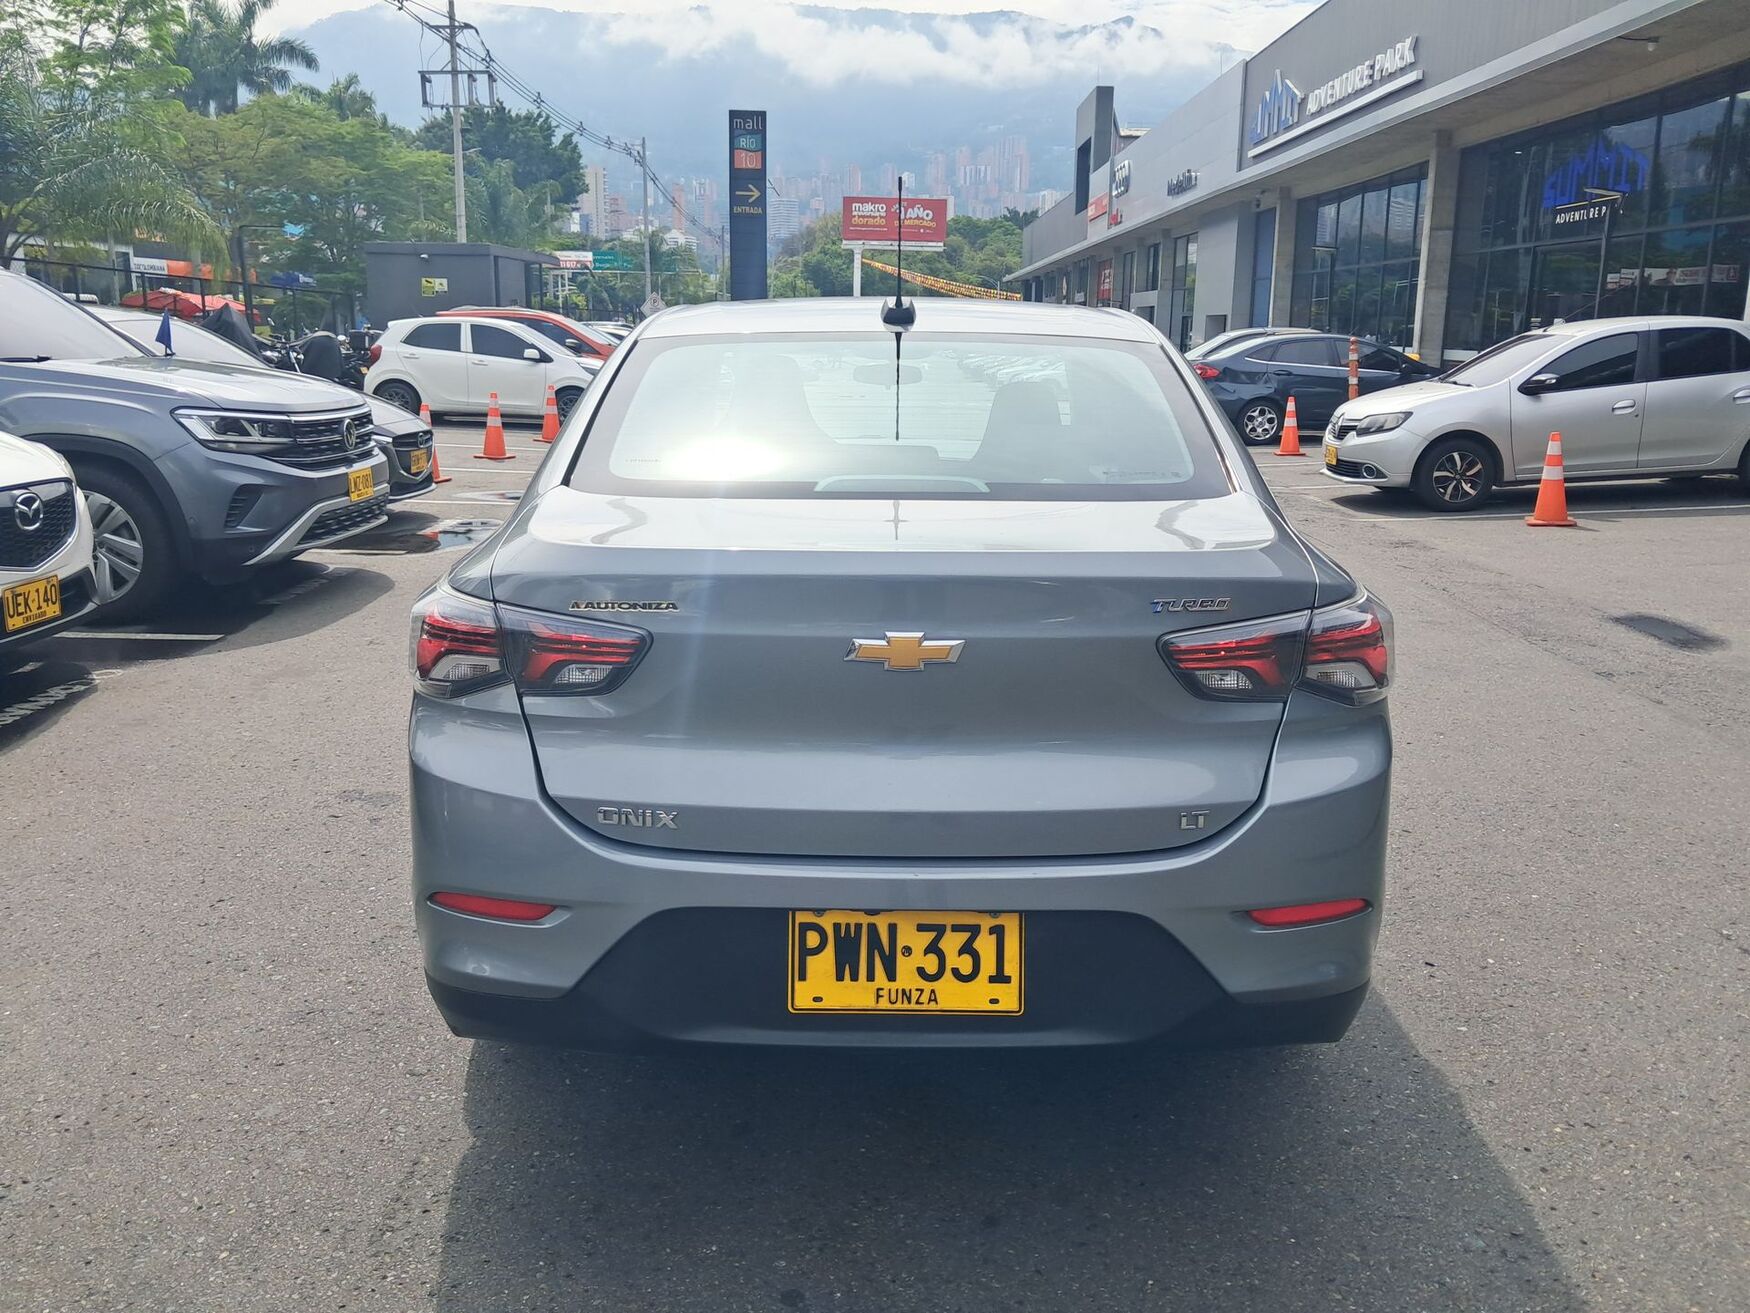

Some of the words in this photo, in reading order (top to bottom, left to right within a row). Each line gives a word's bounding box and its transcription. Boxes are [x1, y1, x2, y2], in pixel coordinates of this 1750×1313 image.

[1306, 60, 1374, 115] ADVENTURE
[1374, 35, 1418, 81] PARK
[733, 115, 763, 130] mall
[740, 135, 756, 149] RÍO
[741, 153, 756, 168] 10
[733, 206, 763, 214] ENTRADA
[852, 202, 887, 213] makro
[906, 203, 934, 220] AÑO
[852, 216, 887, 225] dorado
[904, 218, 937, 228] MERCADO
[1151, 597, 1232, 613] TURBO
[597, 806, 679, 829] ONIX
[1180, 810, 1210, 830] LT
[875, 987, 939, 1006] FUNZA
